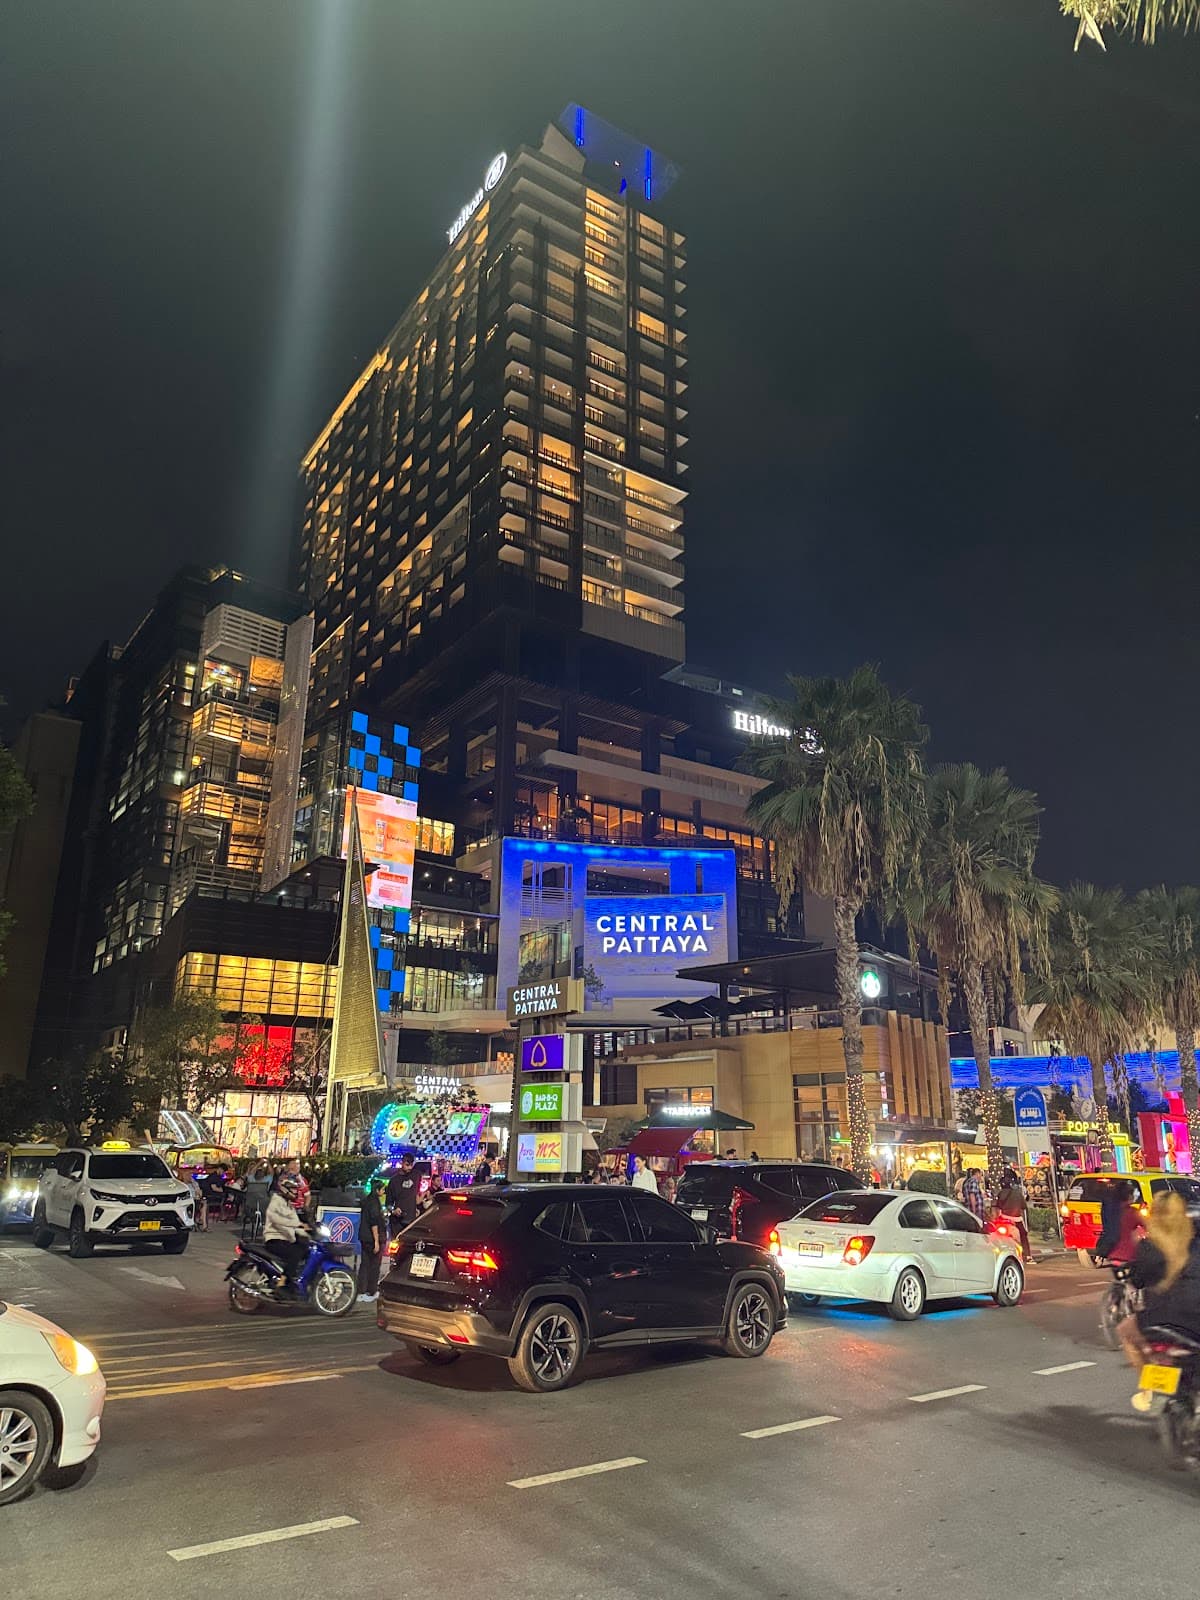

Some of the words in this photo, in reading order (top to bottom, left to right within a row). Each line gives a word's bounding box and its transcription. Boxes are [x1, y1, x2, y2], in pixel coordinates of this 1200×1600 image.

[449, 187, 484, 245] Hilton
[734, 710, 791, 738] Hilton
[596, 914, 715, 933] CENTRAL
[603, 935, 708, 953] PATTAYA
[513, 983, 561, 1002] CENTRAL
[515, 998, 558, 1016] PATTAYA
[415, 1075, 462, 1087] CENTRAL
[535, 1102, 558, 1111] PLAZA
[1067, 1121, 1089, 1132] POP
[536, 1142, 561, 1158] MK
